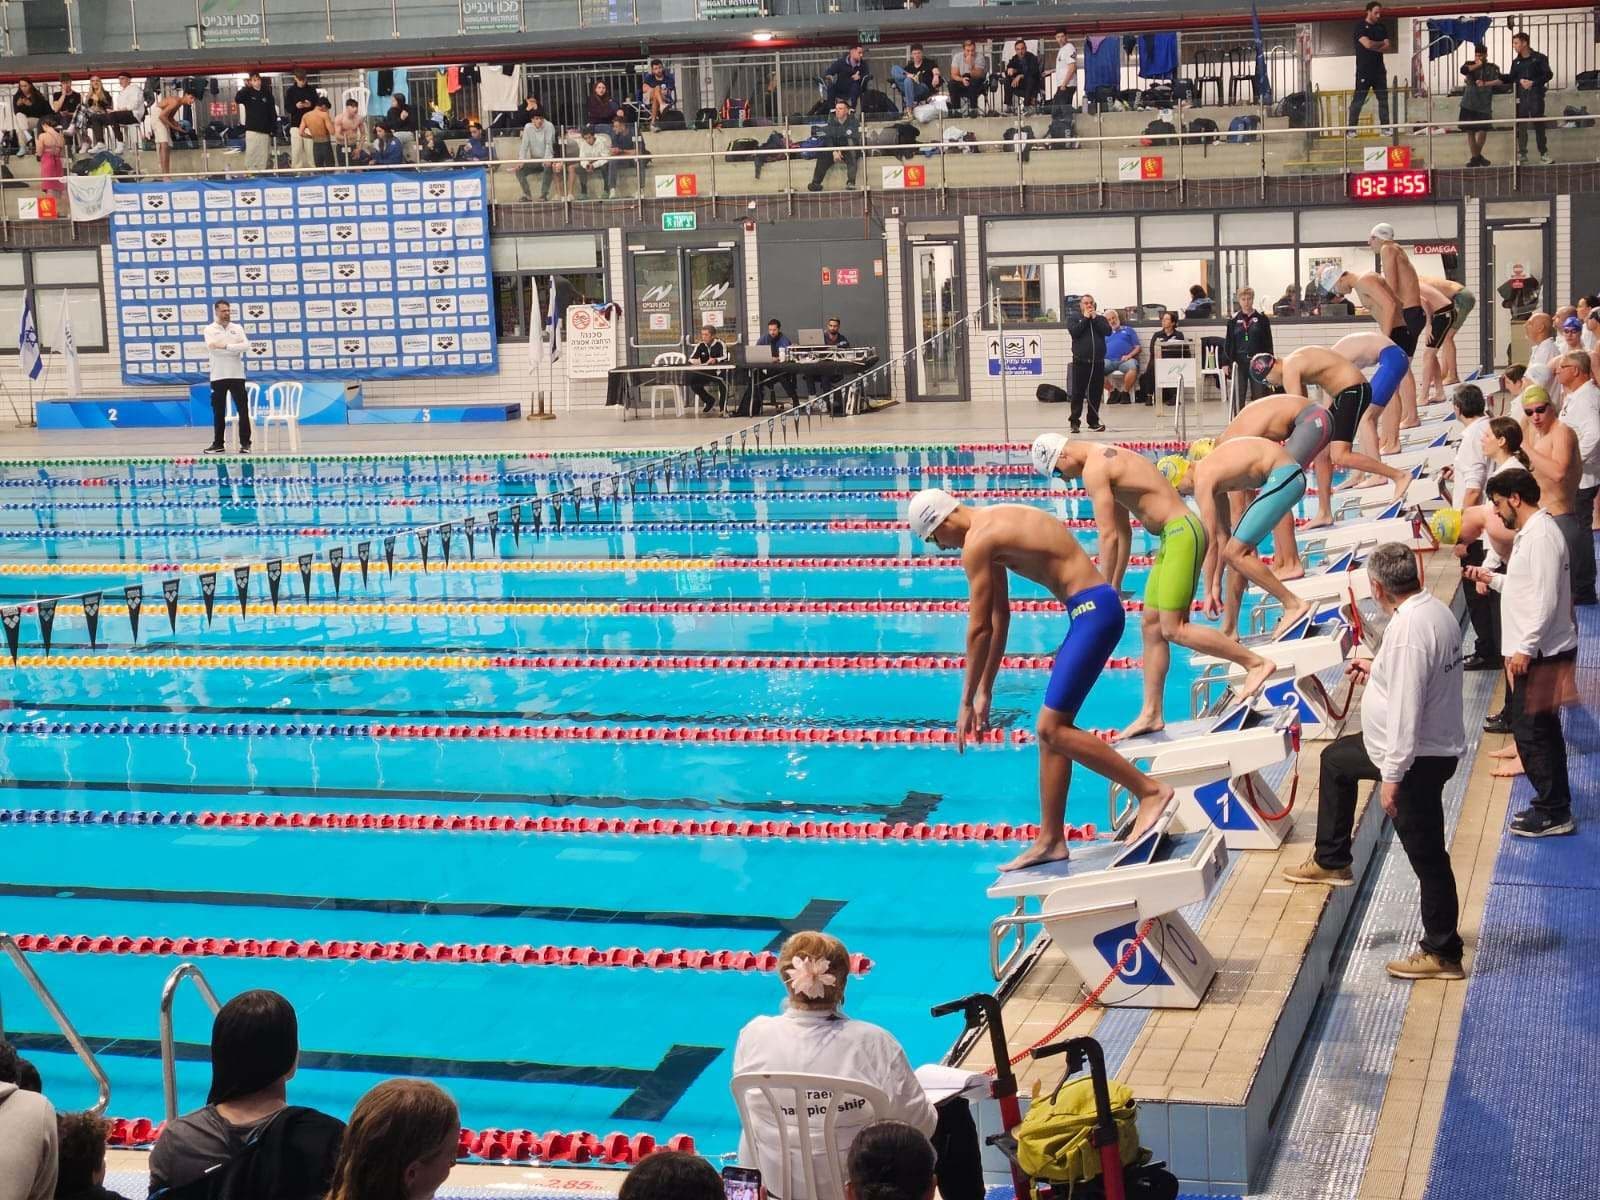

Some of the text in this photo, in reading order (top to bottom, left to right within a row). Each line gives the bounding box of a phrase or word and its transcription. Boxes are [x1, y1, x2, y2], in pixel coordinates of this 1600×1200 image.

[496, 0, 519, 15] מכון
[237, 14, 259, 28] מכון
[1356, 174, 1425, 196] 19:21:55
[1424, 245, 1457, 254] OMEGA
[108, 408, 118, 420] 2
[422, 407, 430, 421] 3
[1282, 691, 1299, 710] 2
[1216, 793, 1229, 824] 1
[1116, 938, 1142, 977] 0
